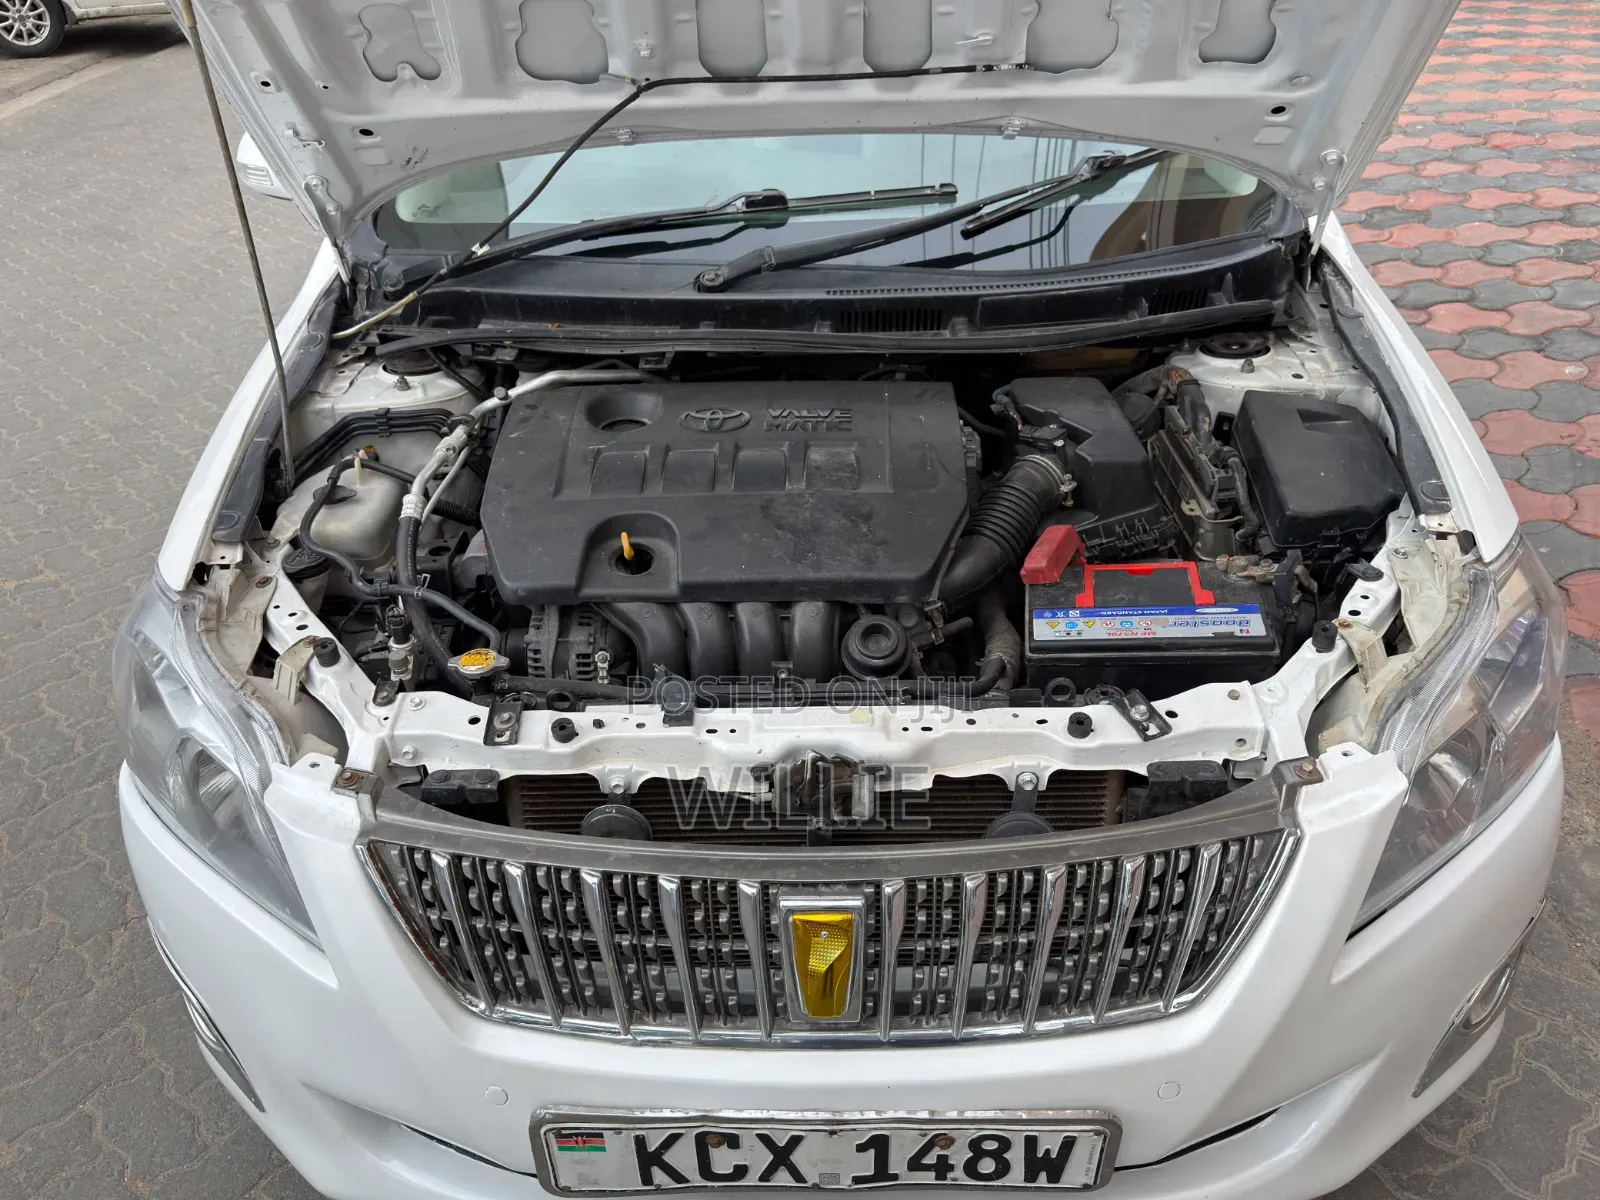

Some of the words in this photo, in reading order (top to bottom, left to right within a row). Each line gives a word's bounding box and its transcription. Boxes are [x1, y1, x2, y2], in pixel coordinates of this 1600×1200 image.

[766, 408, 852, 418] VALVE
[764, 419, 853, 432] MATIC
[1171, 619, 1251, 628] Booster
[633, 1131, 808, 1186] KCX
[850, 1132, 1078, 1184] 148W
